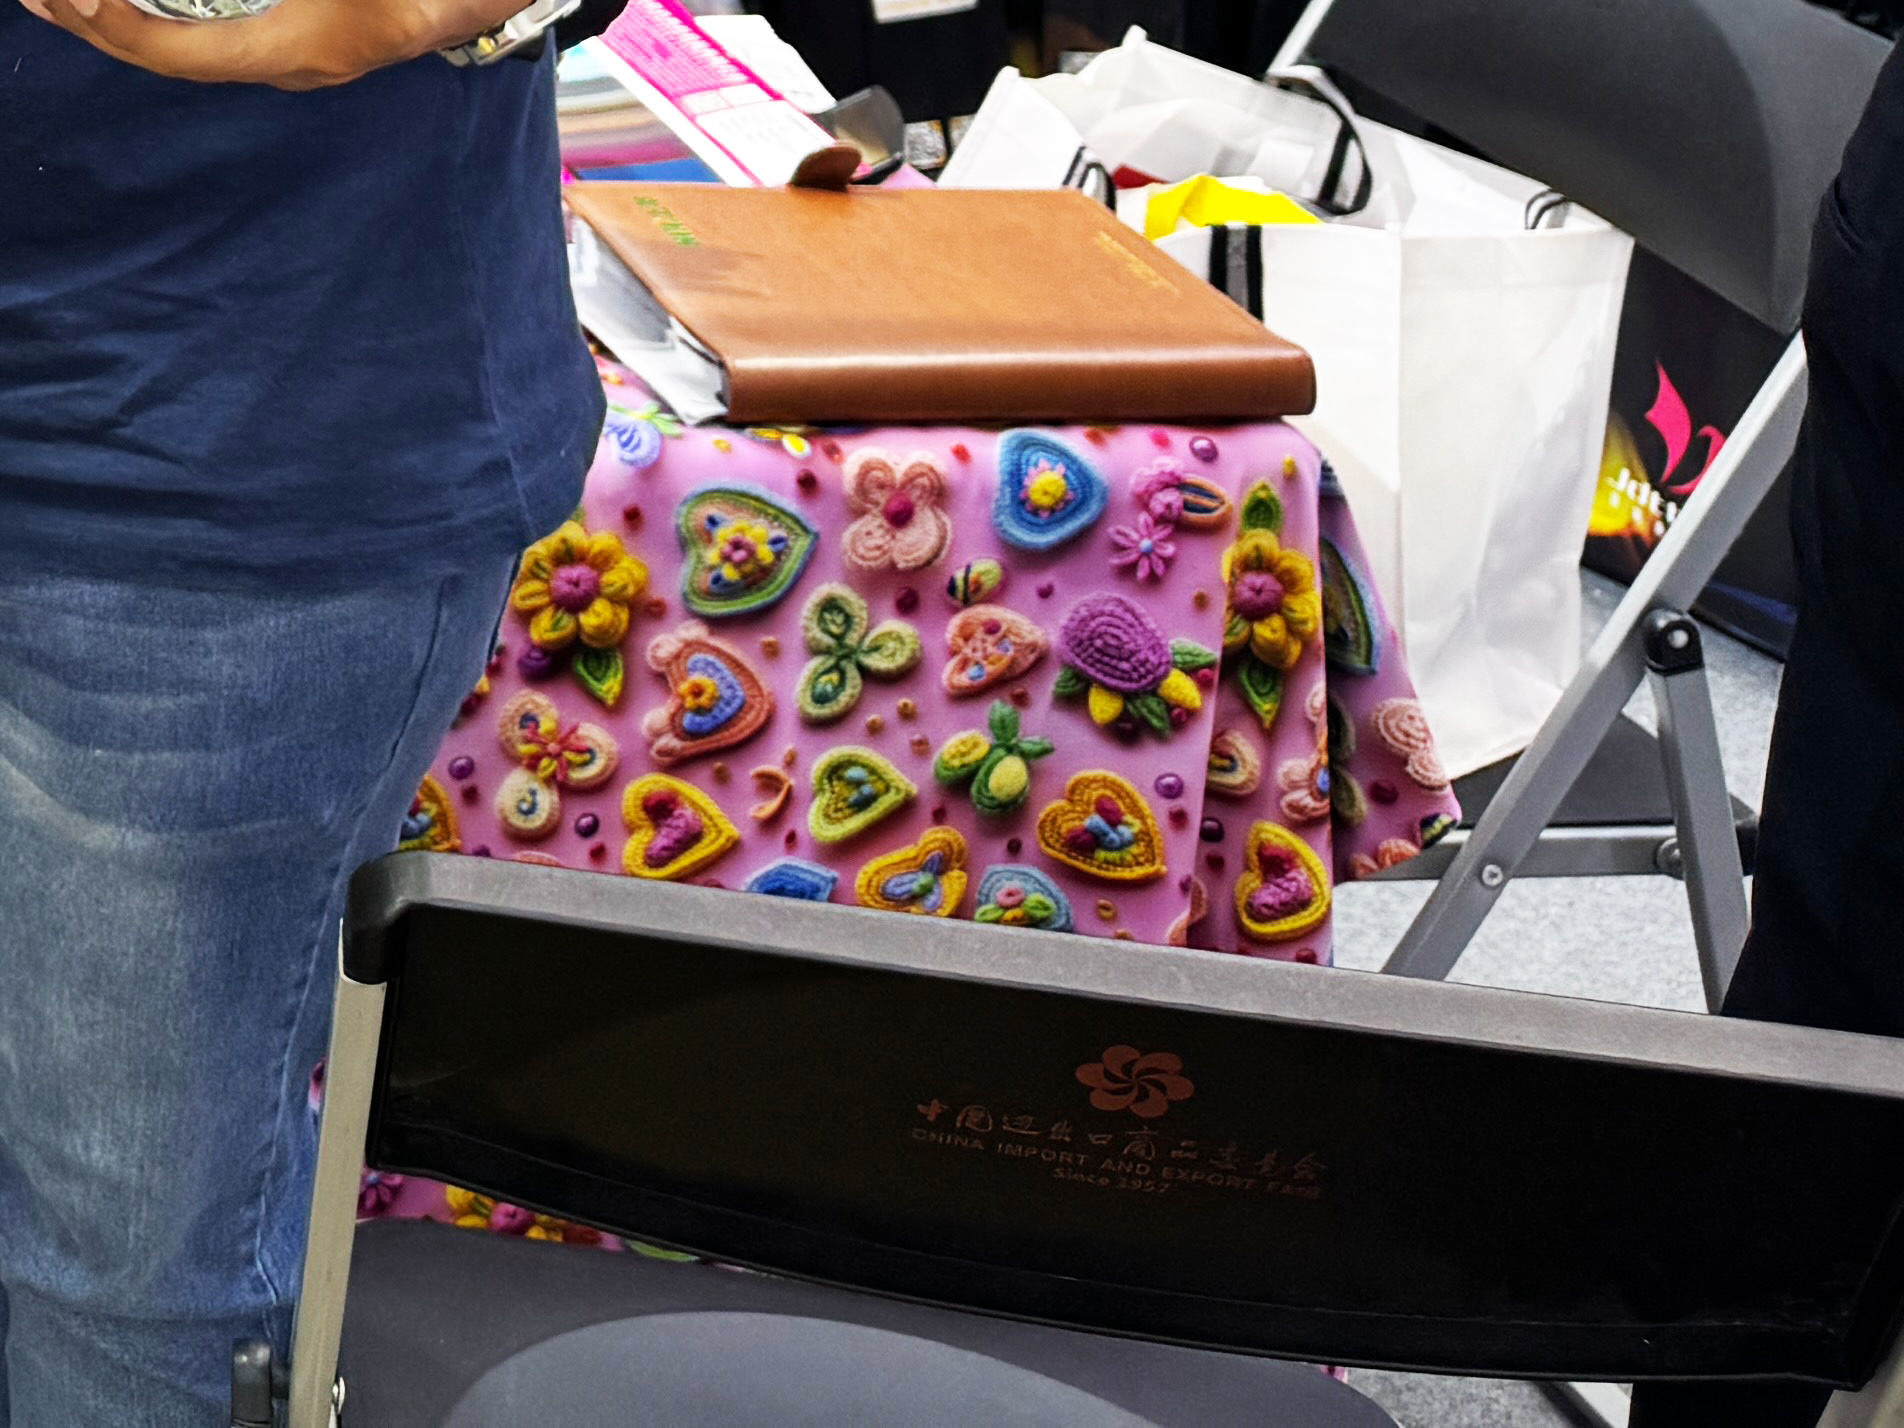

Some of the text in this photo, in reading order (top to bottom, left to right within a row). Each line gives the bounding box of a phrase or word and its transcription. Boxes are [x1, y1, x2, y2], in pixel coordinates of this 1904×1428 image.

[912, 1128, 984, 1151] CHINA
[997, 1142, 1087, 1165] IMPORT
[1101, 1158, 1150, 1176] AND
